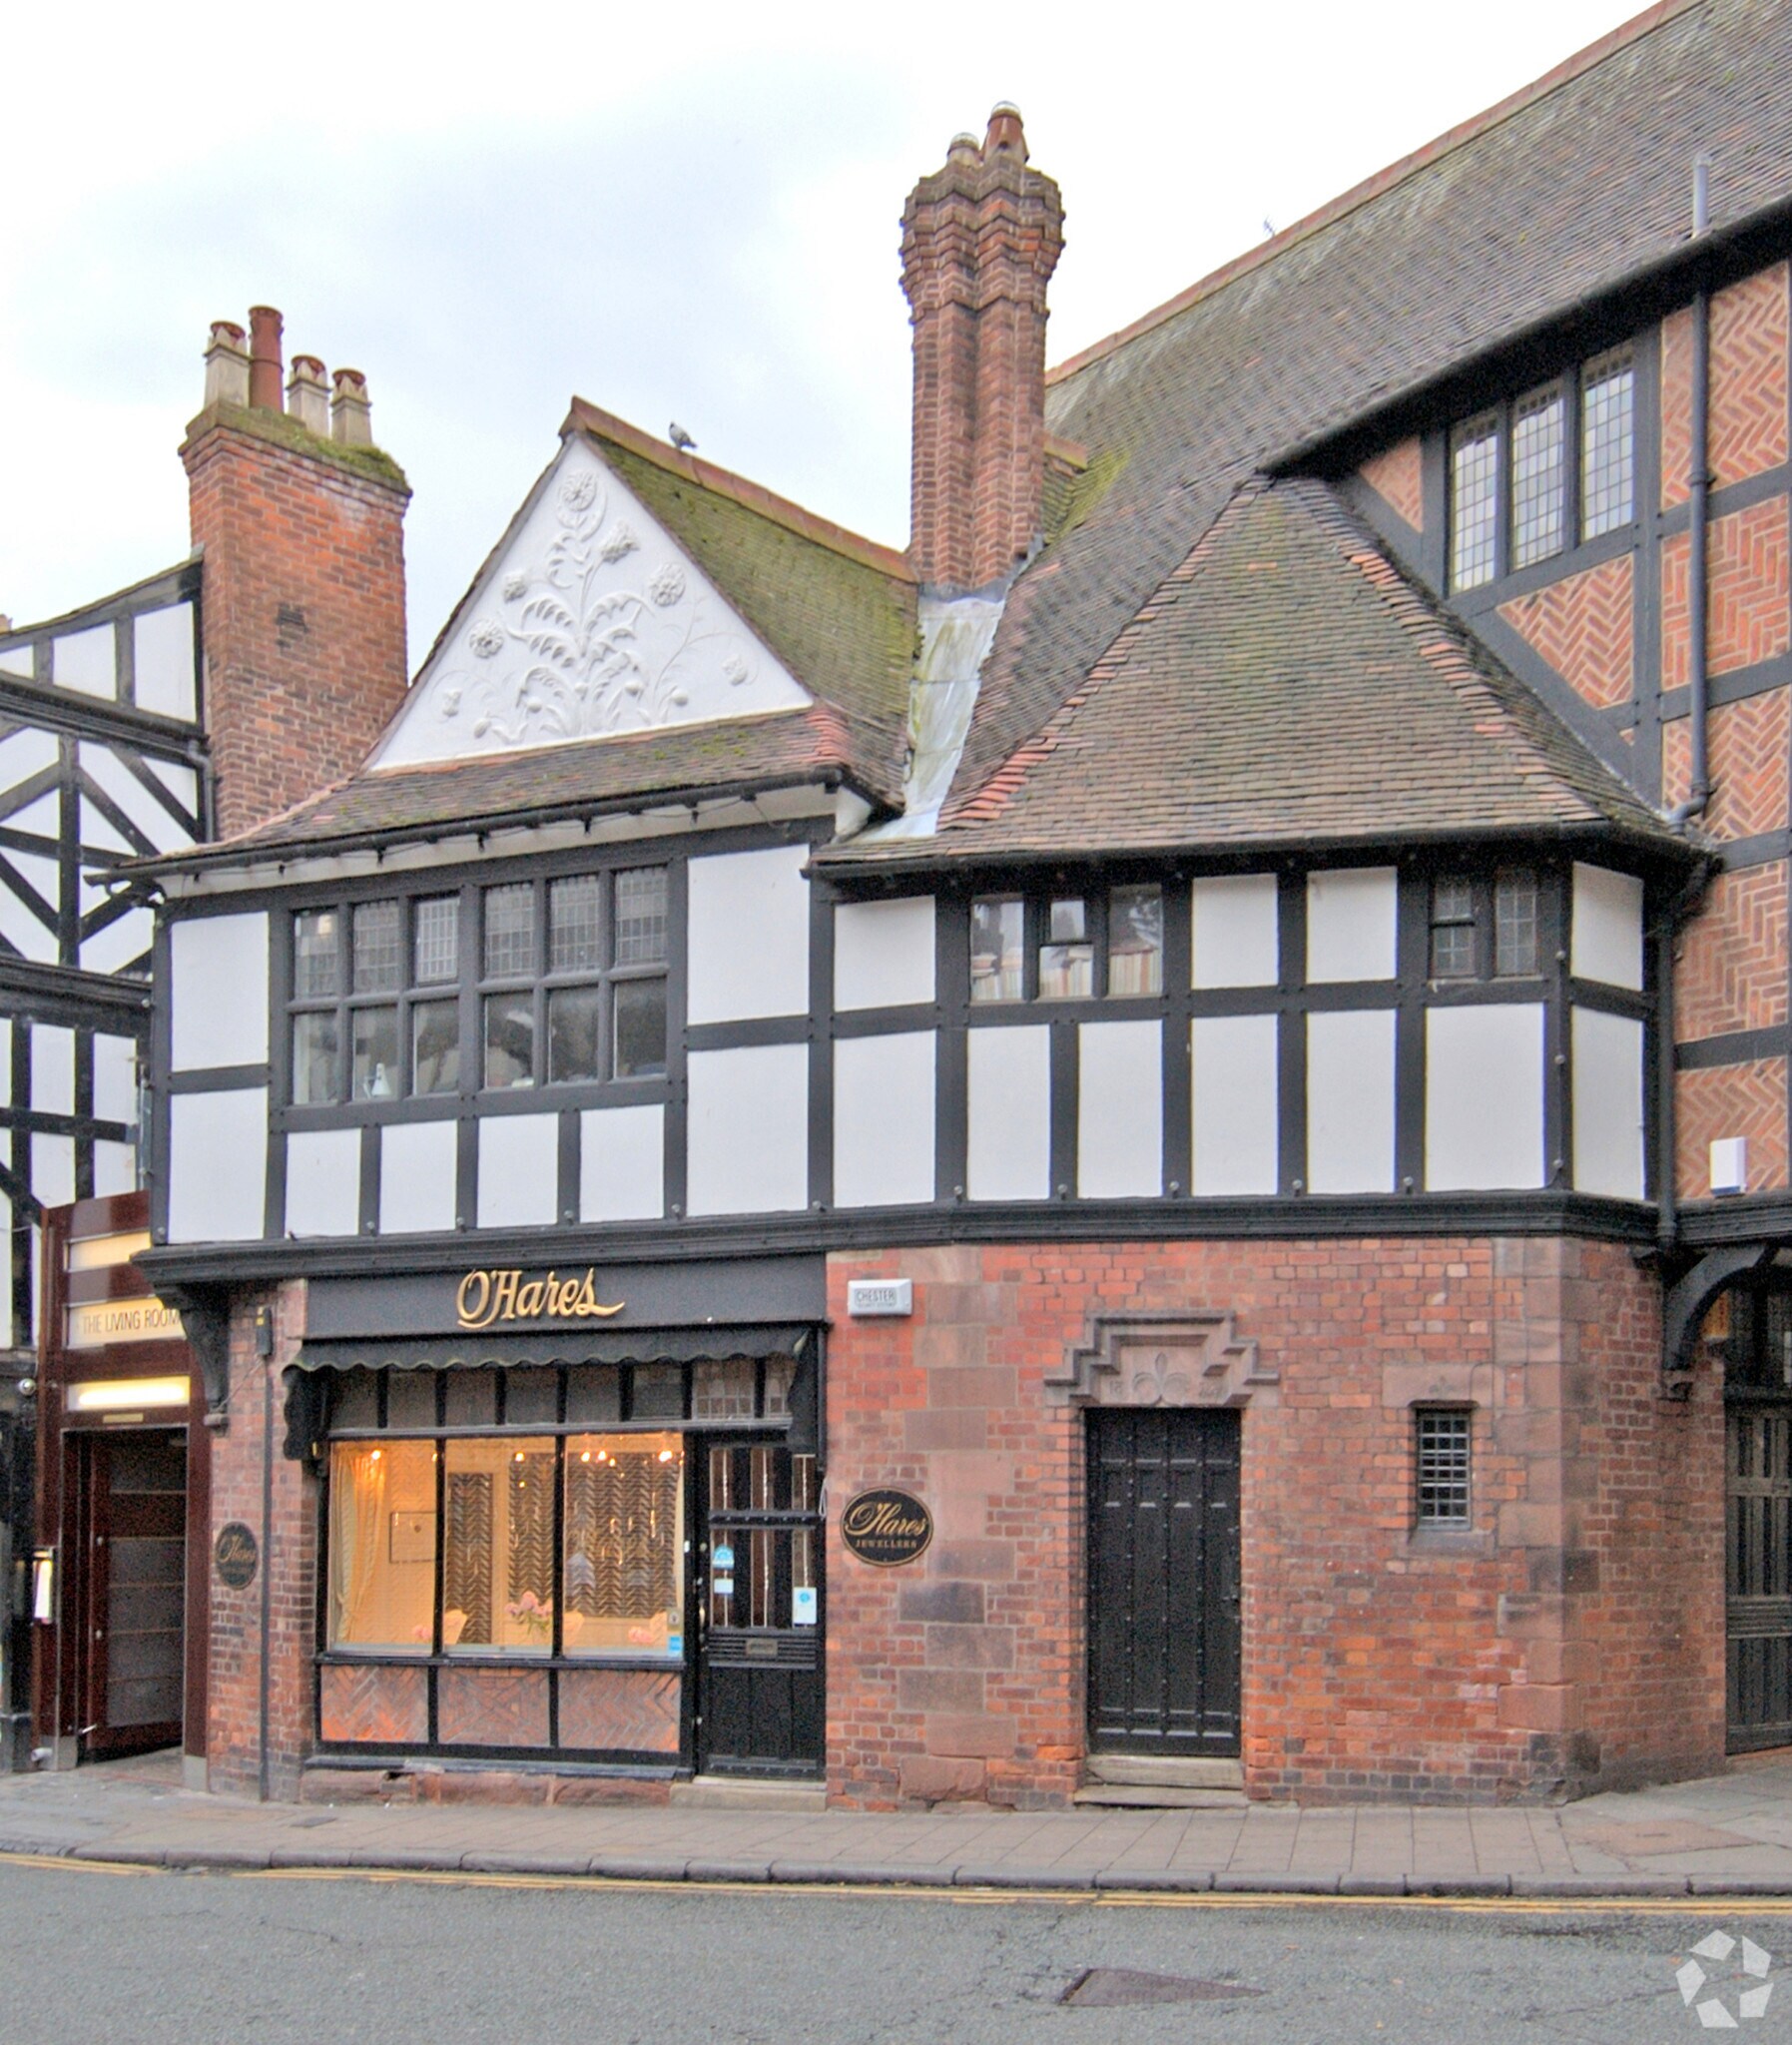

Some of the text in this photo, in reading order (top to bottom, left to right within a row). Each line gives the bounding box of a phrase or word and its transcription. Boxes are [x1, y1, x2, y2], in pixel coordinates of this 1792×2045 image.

[456, 1267, 626, 1329] O'Hares
[856, 1289, 896, 1302] CHESTER
[83, 1307, 181, 1335] THE LIVING ROOM
[845, 1502, 928, 1536] O'Hares
[856, 1540, 917, 1549] JEWELLERS
